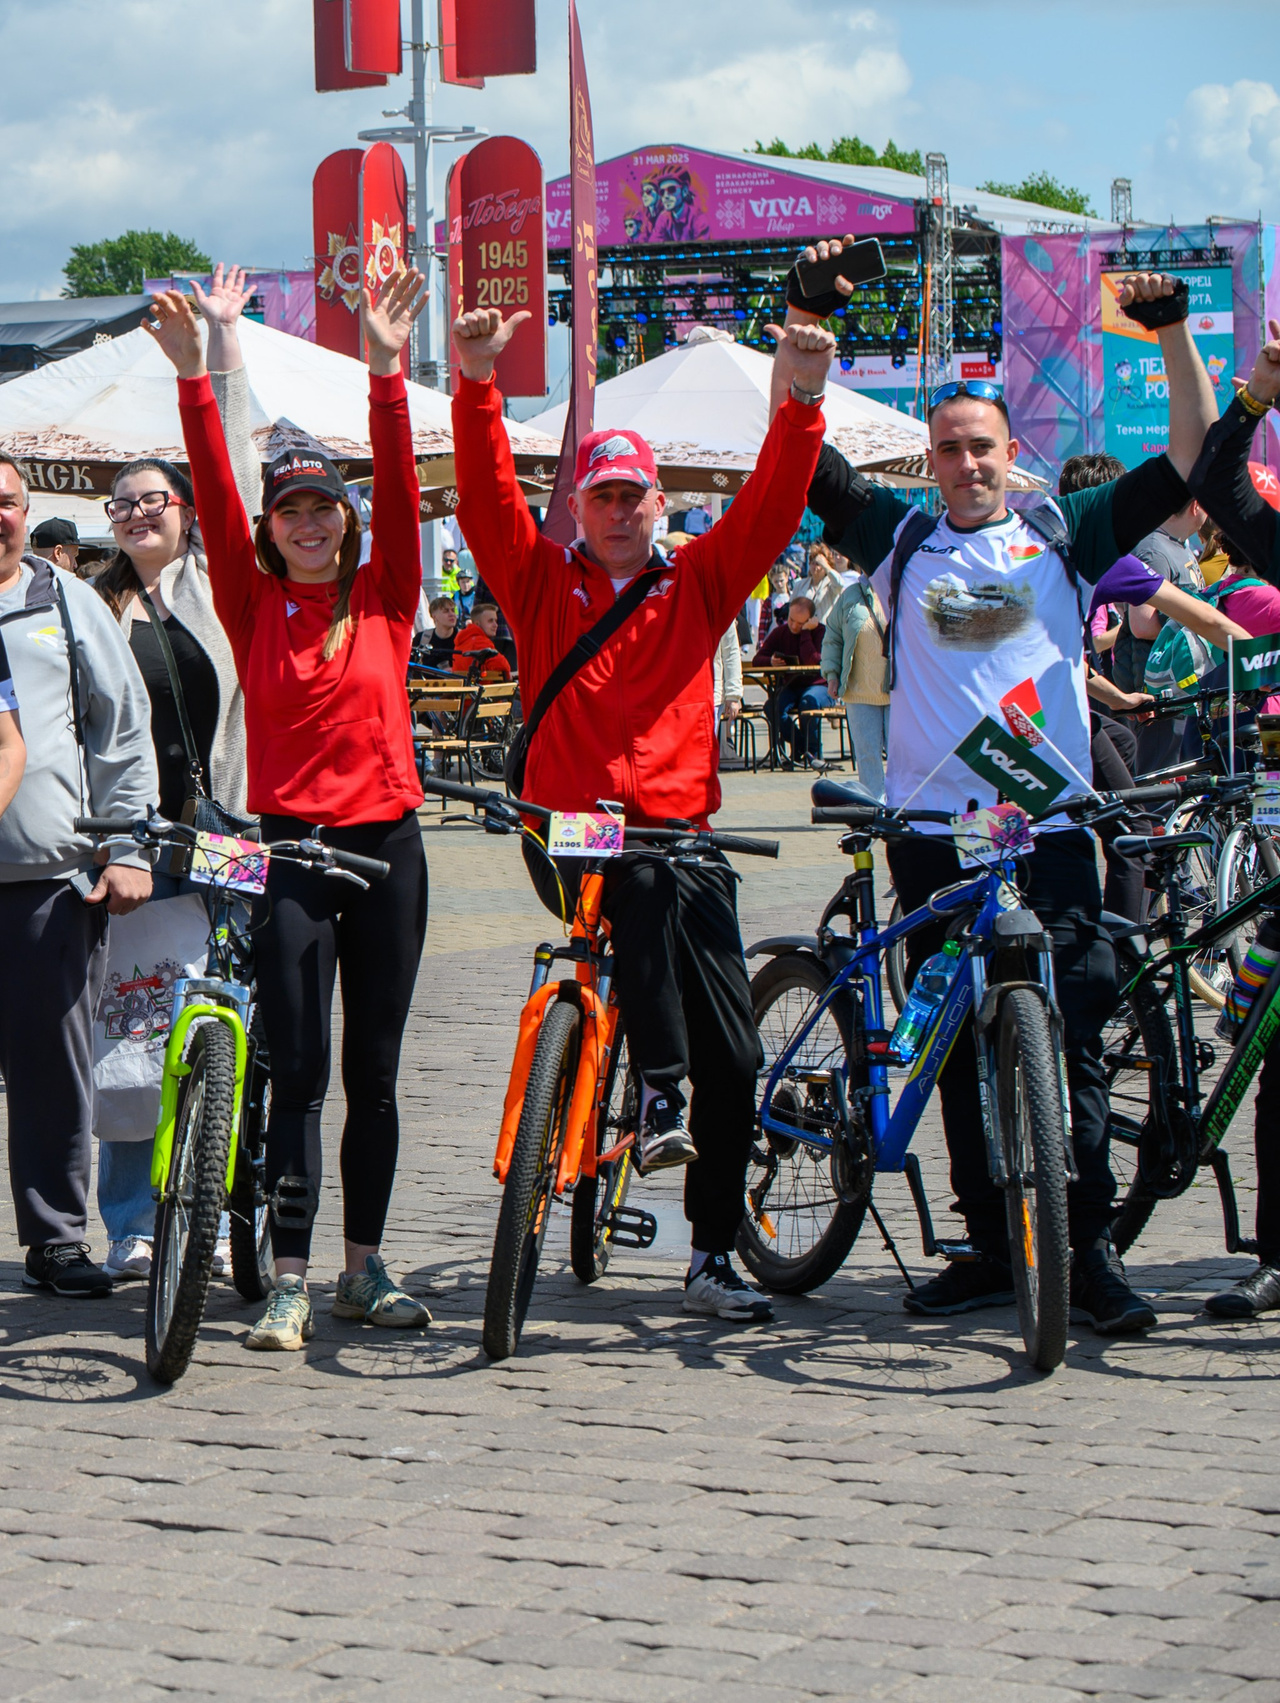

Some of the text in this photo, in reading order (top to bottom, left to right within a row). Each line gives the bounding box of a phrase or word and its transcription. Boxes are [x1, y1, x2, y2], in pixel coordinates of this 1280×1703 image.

[667, 153, 690, 164] 2025
[463, 188, 541, 235] Победа
[749, 196, 814, 218] VIVA
[478, 240, 528, 270] 1945
[476, 276, 529, 306] 2025
[1116, 423, 1143, 436] Тема
[23, 462, 95, 491] НСК
[918, 984, 974, 1095] AUTHOR
